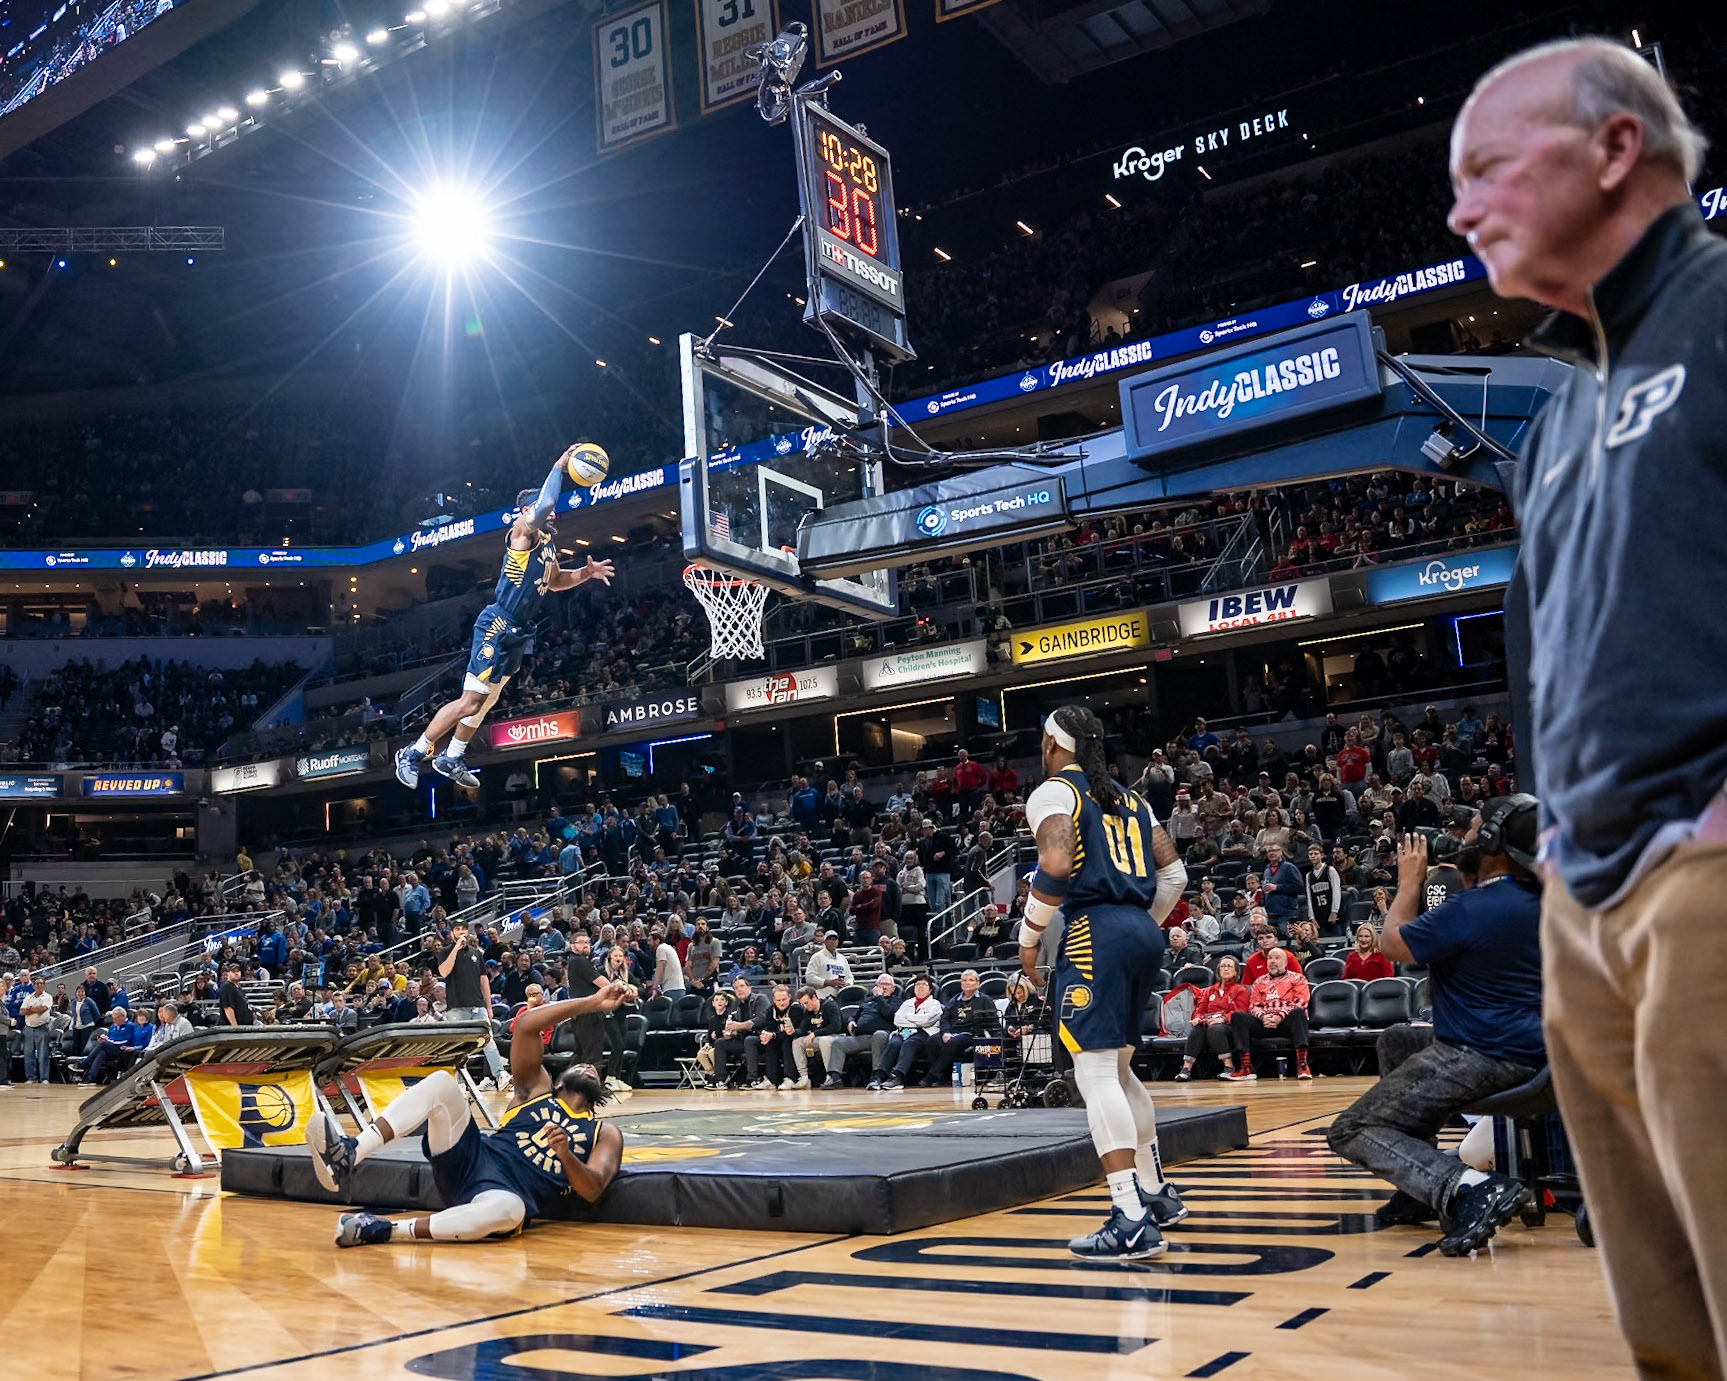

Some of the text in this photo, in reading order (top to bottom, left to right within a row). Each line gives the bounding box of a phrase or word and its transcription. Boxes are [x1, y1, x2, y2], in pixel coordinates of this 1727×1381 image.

[610, 17, 652, 68] 30
[1112, 109, 1289, 181] Kroger SKY DECK
[822, 131, 877, 193] 10:28
[825, 170, 878, 256] 30
[843, 254, 898, 296] TISSOT
[951, 491, 1050, 522] Sports Tech HQ
[1418, 560, 1480, 591] Kroger
[1208, 584, 1299, 621] IBEW
[1208, 609, 1297, 632] LOCAL 481
[1039, 620, 1141, 653] GAINBRIDGE
[897, 647, 962, 664] Peyton Manning
[898, 654, 972, 673] Children's Hospital
[746, 678, 818, 704] 93.5 fan 107.5
[763, 676, 790, 692] the
[607, 697, 699, 725] AMBROSE
[527, 719, 560, 739] mhs
[310, 754, 340, 771] Ruoff
[93, 779, 161, 791] REVVED UP
[1102, 814, 1147, 877] 01
[1316, 894, 1327, 906] 15
[1427, 885, 1446, 895] CSC
[530, 1107, 588, 1155] INDIANA
[515, 1131, 562, 1174] PACERS
